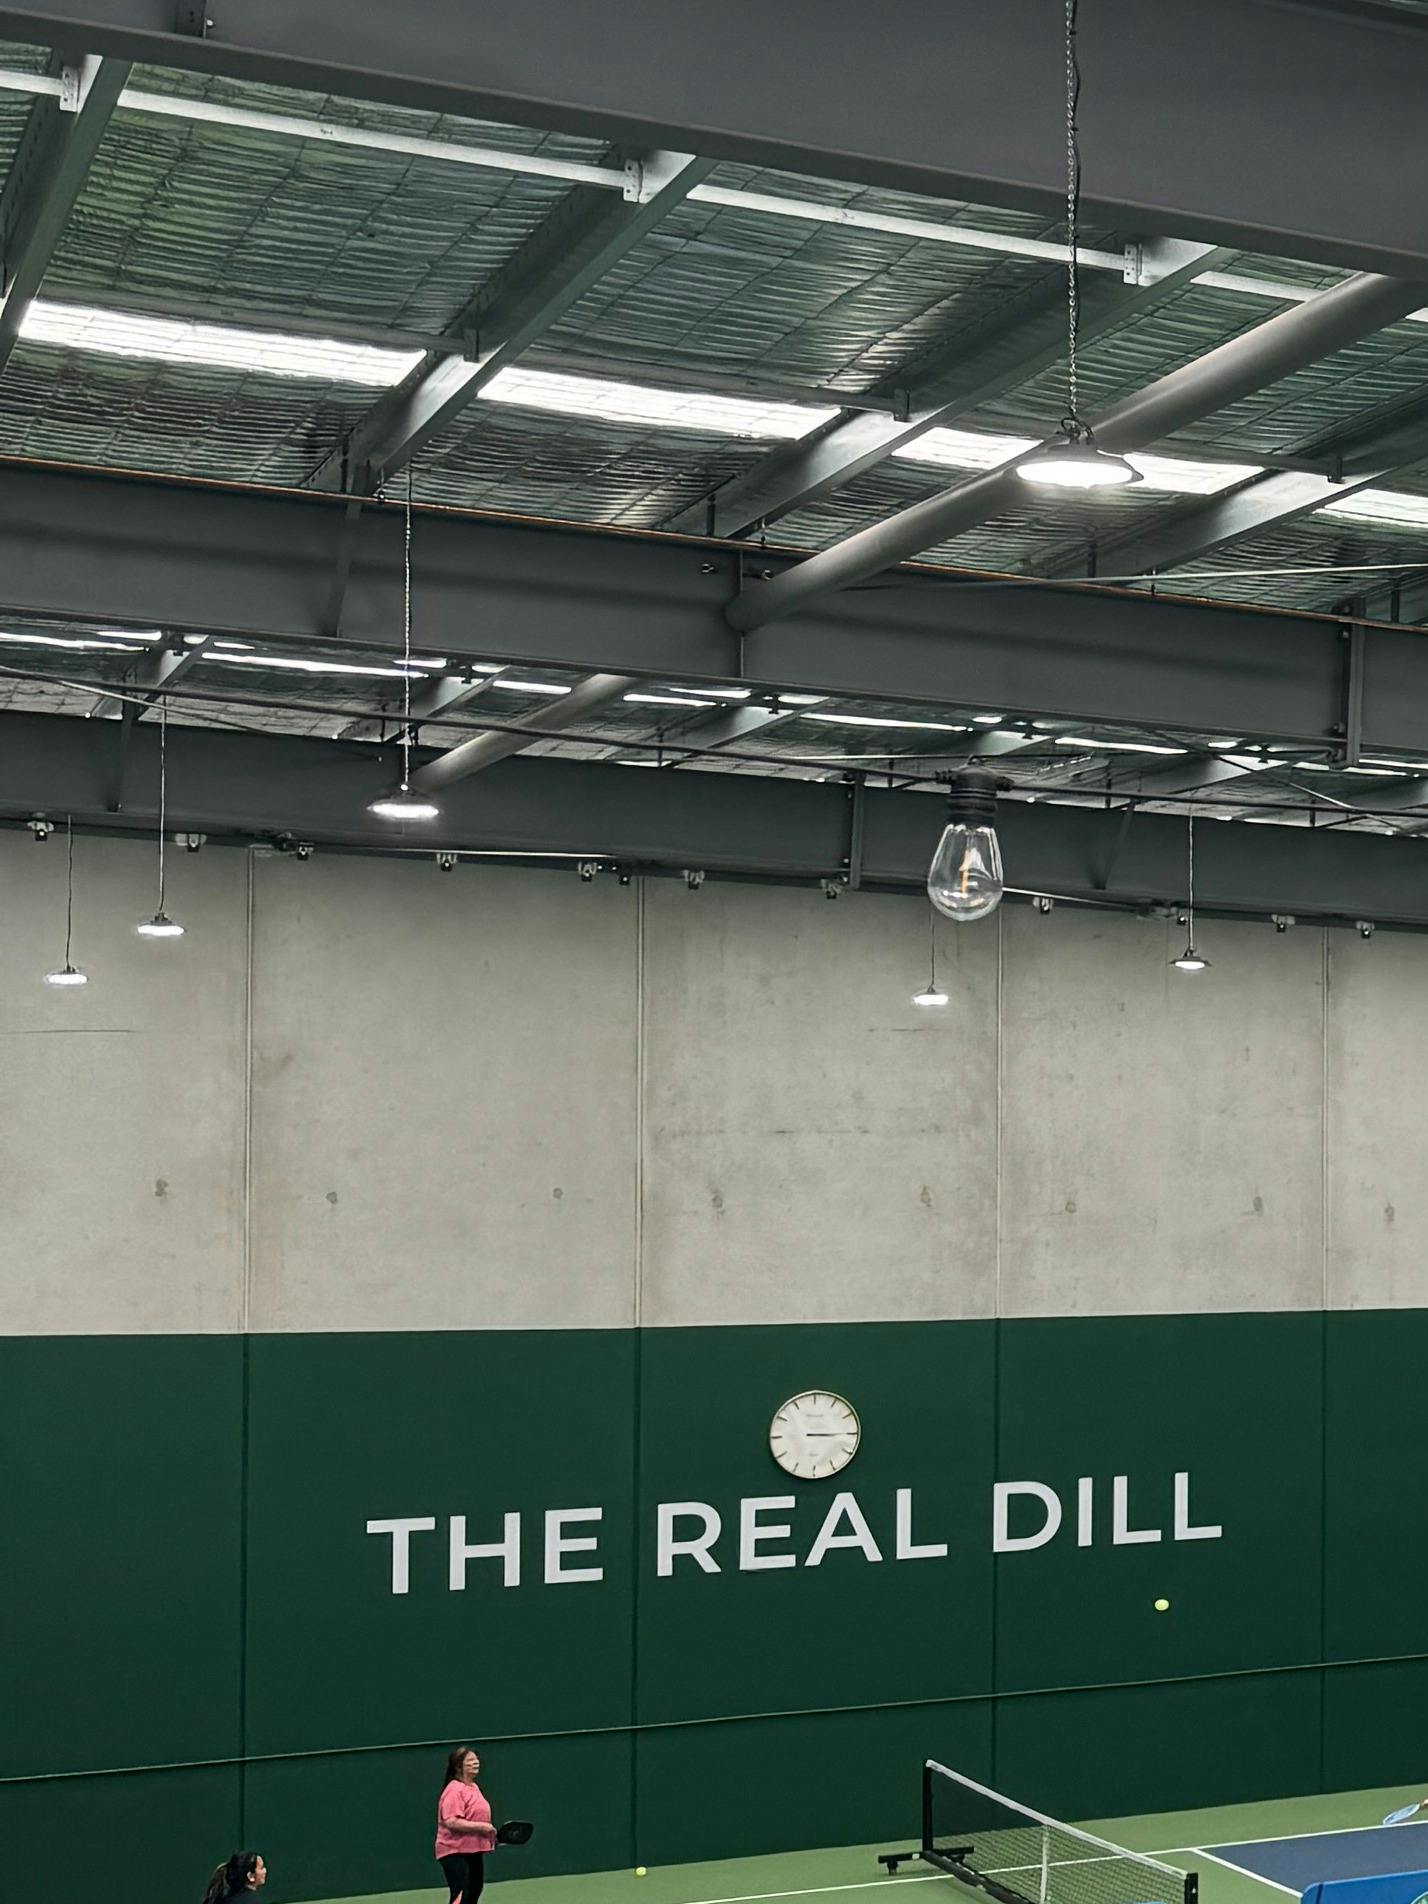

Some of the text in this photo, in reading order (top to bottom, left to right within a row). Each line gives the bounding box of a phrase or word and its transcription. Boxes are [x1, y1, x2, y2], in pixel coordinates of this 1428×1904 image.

[366, 1472, 1222, 1594] THE REAL DILL
